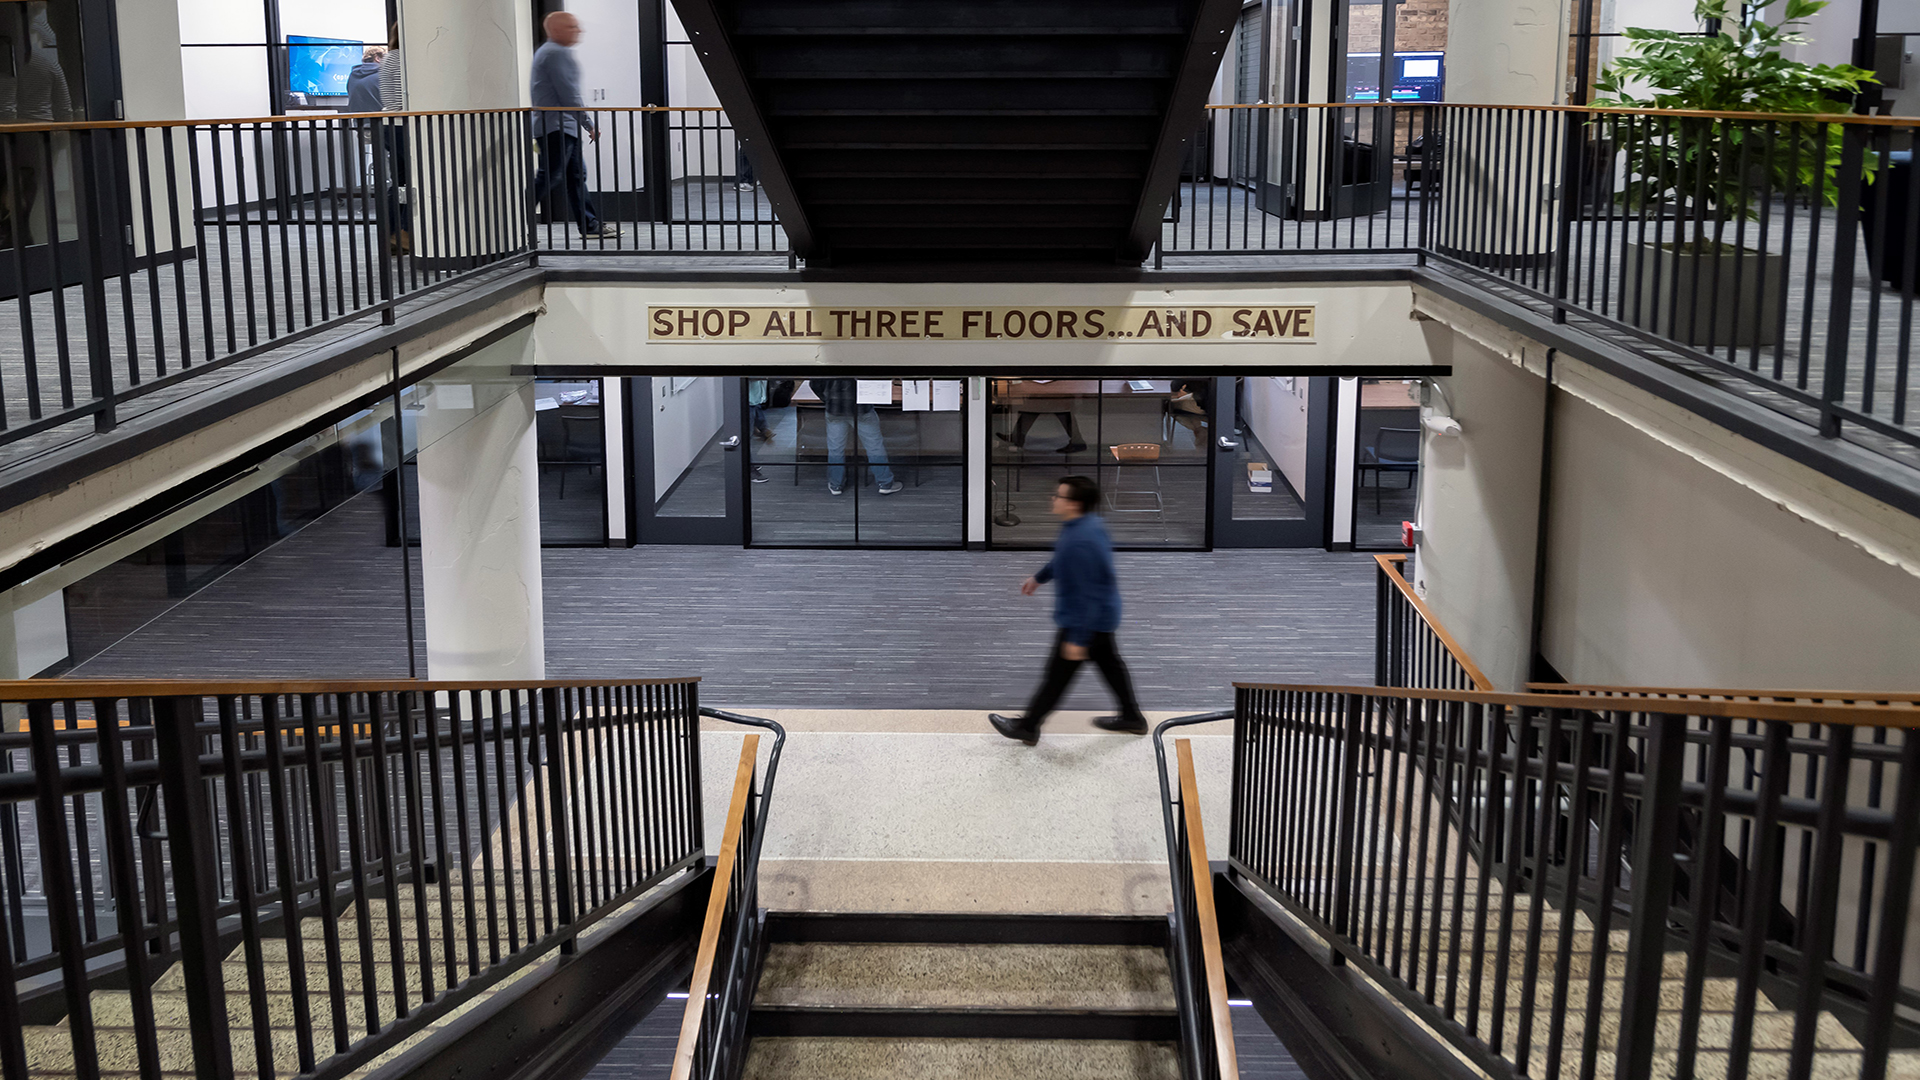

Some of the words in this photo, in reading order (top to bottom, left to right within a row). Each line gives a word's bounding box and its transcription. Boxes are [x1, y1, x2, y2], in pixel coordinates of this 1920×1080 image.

[653, 309, 750, 337] SHOP
[763, 310, 822, 337] ALL
[829, 310, 943, 338] THREE
[1233, 309, 1312, 338] SAVE
